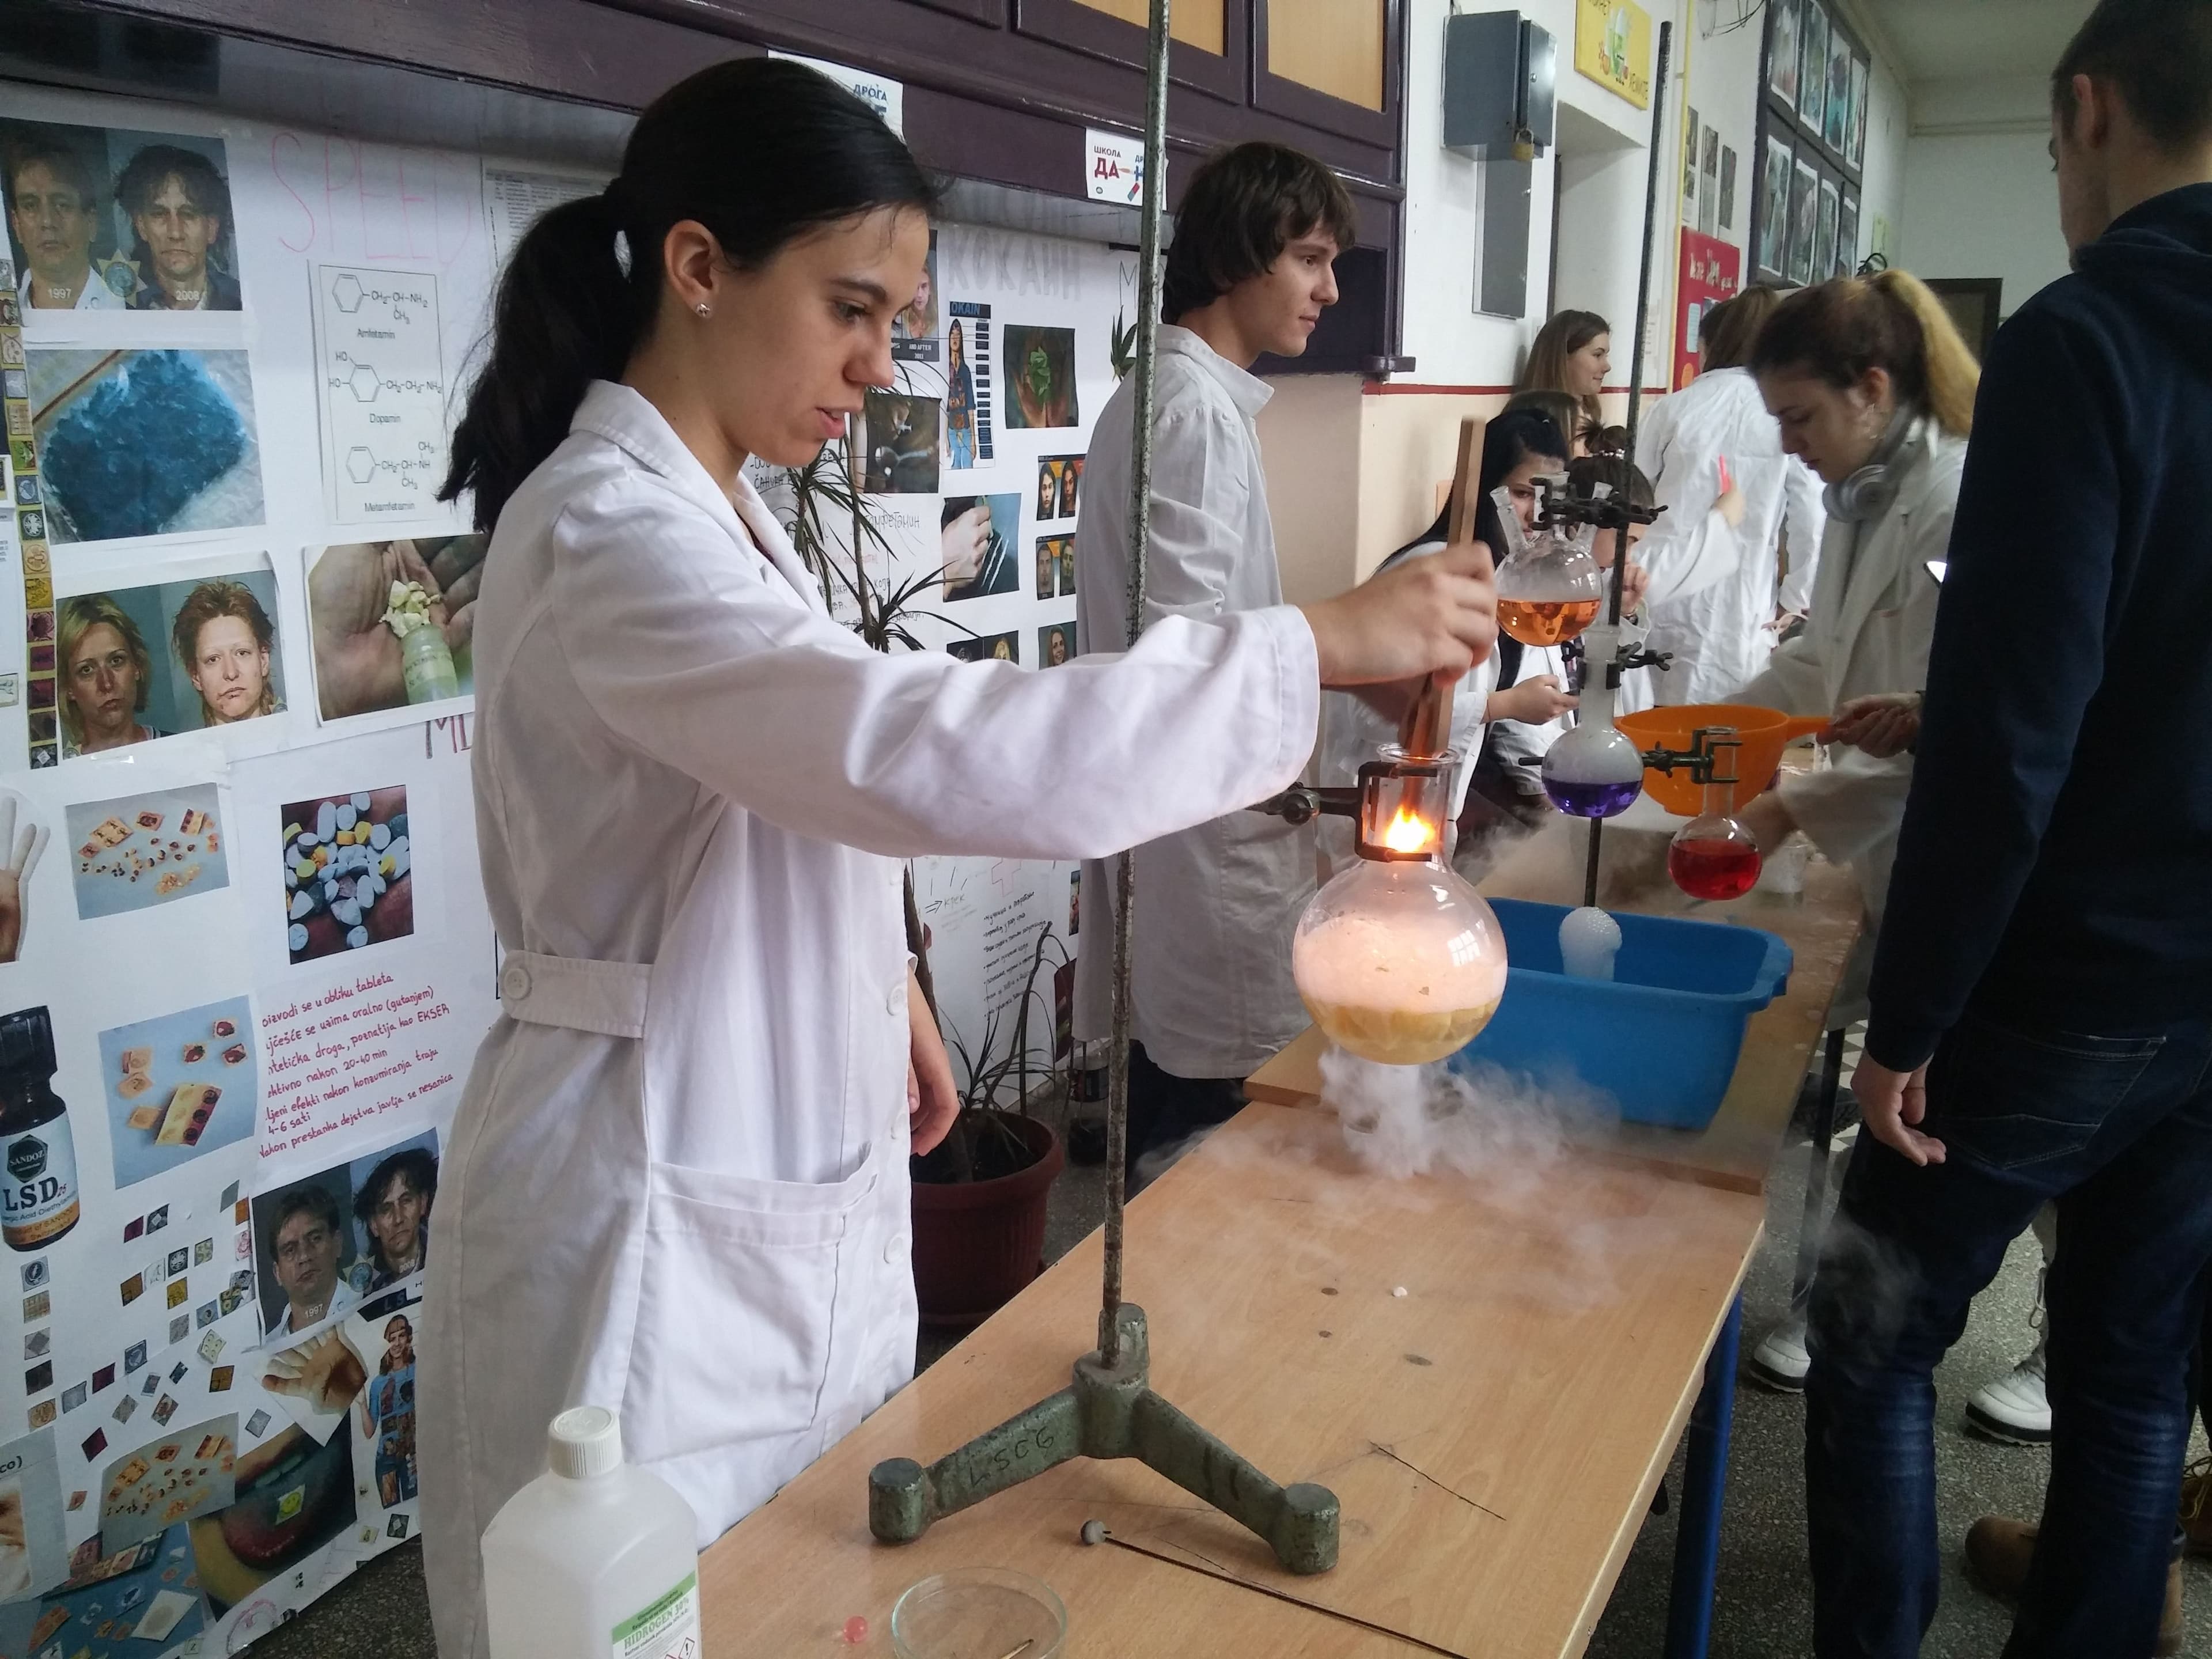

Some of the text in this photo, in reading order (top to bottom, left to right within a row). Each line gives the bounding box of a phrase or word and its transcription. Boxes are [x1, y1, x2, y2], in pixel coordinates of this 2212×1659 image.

[853, 84, 888, 101] ДРОГА
[1094, 145, 1122, 158] ШКОЛА
[1094, 157, 1120, 180] ДА
[272, 132, 471, 265] SPEED
[48, 288, 200, 301] 1997 2008
[357, 328, 396, 340] Amfetamin
[369, 413, 401, 425] Dopamin
[365, 502, 415, 512] Metamfetamin
[302, 1001, 312, 1012] se
[316, 999, 323, 1007] u
[324, 986, 354, 1004] obliku
[356, 972, 394, 993] tableta
[305, 1025, 316, 1036] se
[320, 1014, 350, 1030] uzima
[353, 1003, 384, 1019] oralno
[386, 986, 434, 1012] (gutanjem)
[315, 1042, 350, 1058] droga,
[350, 1022, 397, 1047] poznatija
[399, 1017, 413, 1028] kao
[418, 1003, 450, 1022] EKSER
[306, 1067, 338, 1083] nakon
[343, 1056, 370, 1070] 20-40
[372, 1050, 388, 1059] min
[266, 1049, 438, 1124] ljeni efekti nakon konzumiranja traju
[291, 1122, 339, 1149] prestanka
[341, 1106, 375, 1126] dejstva
[377, 1096, 404, 1114] javlja
[407, 1091, 417, 1100] se
[419, 1073, 453, 1094] nesanica
[268, 1112, 310, 1135] 4-6 sati
[10, 1150, 45, 1166] SANDOZ
[3, 1176, 58, 1211] LSD
[305, 1304, 323, 1319] 1997
[624, 1607, 673, 1650] HIDROGEN
